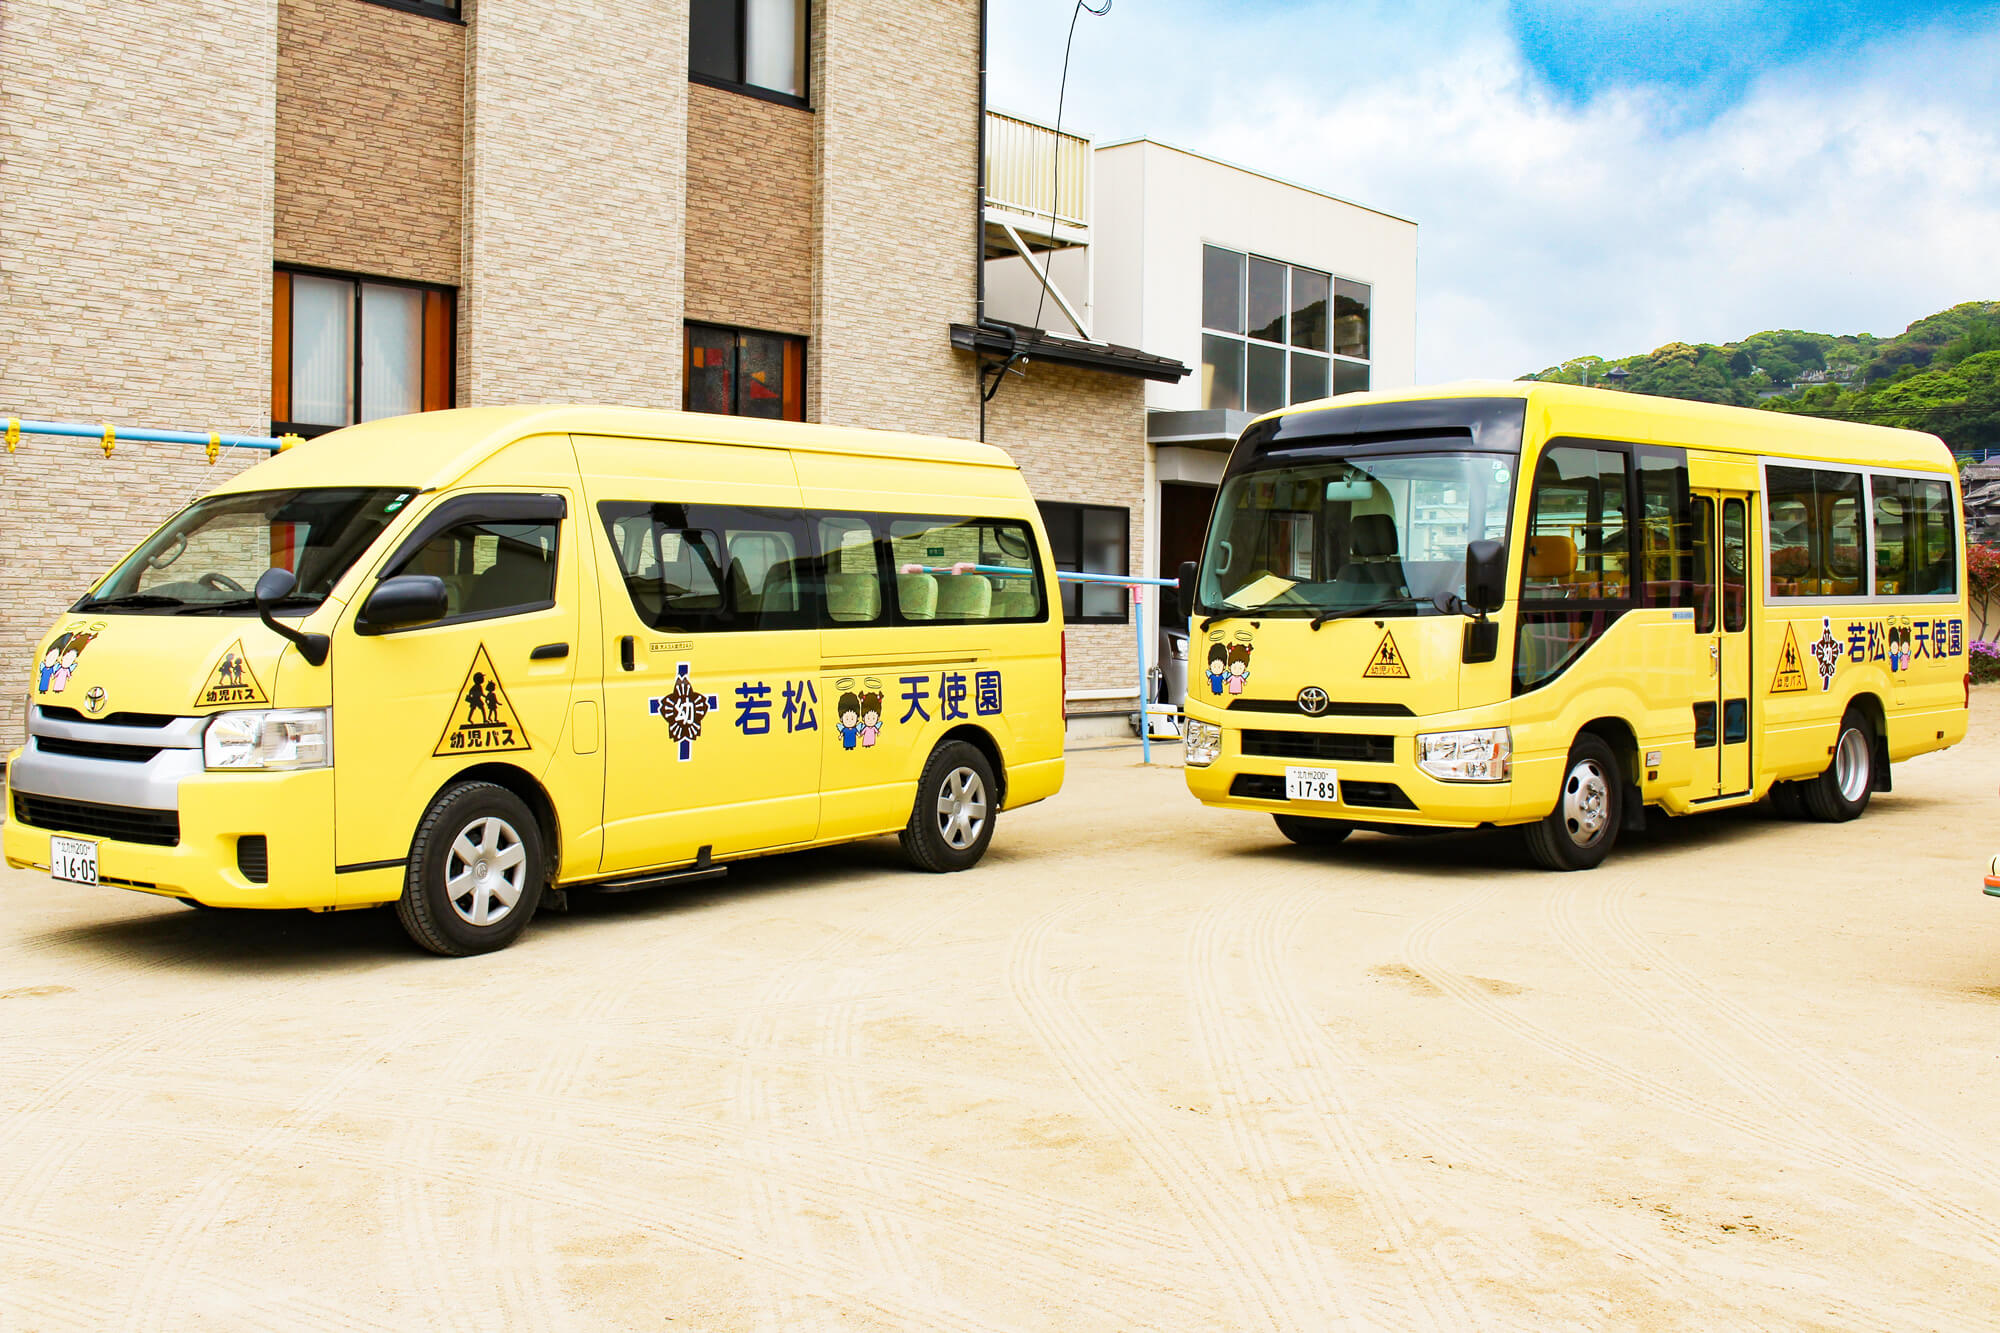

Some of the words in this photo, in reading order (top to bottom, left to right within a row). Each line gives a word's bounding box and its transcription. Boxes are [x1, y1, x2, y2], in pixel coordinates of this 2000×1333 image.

[1847, 621, 1886, 663] 若松
[1913, 619, 1963, 659] 天使園
[206, 688, 255, 702] 幼児バス
[735, 680, 818, 735] 若松
[899, 670, 1002, 724] 天使園
[675, 697, 695, 725] 幼
[450, 729, 515, 748] 幼児バス
[1298, 780, 1335, 799] 17-89
[63, 855, 96, 882] 16-05
